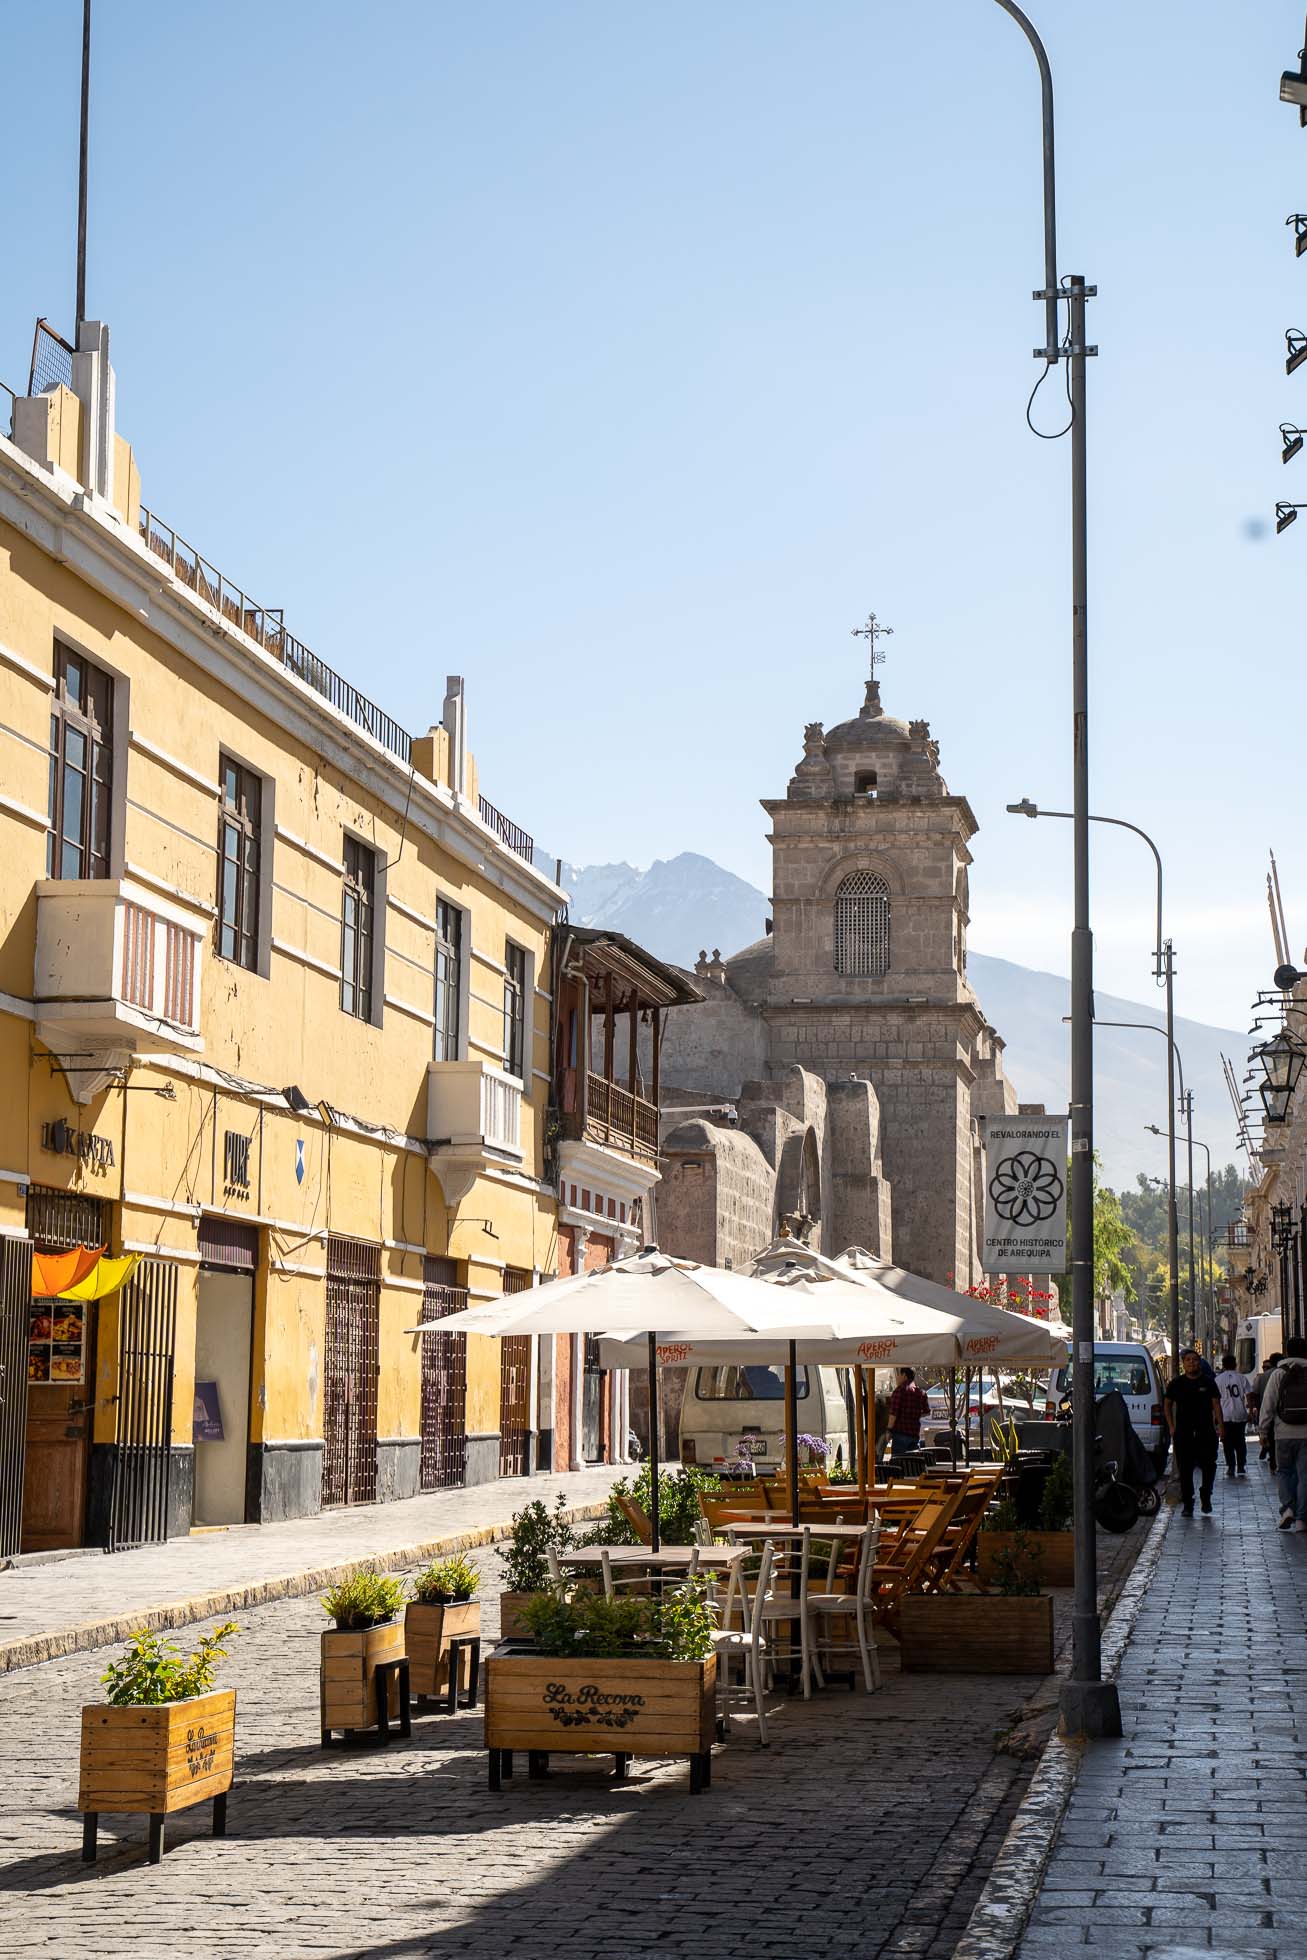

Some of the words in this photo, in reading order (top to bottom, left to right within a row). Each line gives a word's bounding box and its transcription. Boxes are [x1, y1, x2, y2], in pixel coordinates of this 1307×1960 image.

[990, 1130, 1050, 1139] REVALORANDO
[1051, 1130, 1061, 1138] EL
[986, 1238, 1018, 1247] CENTRO
[997, 1248, 1009, 1257] DE
[1010, 1248, 1052, 1258] AREQUIPA
[656, 1343, 694, 1356] APEROL
[857, 1338, 898, 1356] APEROL
[660, 1352, 688, 1364] SPRITZ
[863, 1349, 891, 1361] SPRITZ
[1226, 1383, 1240, 1398] 10
[542, 1682, 575, 1704] La
[576, 1685, 646, 1706] Recova
